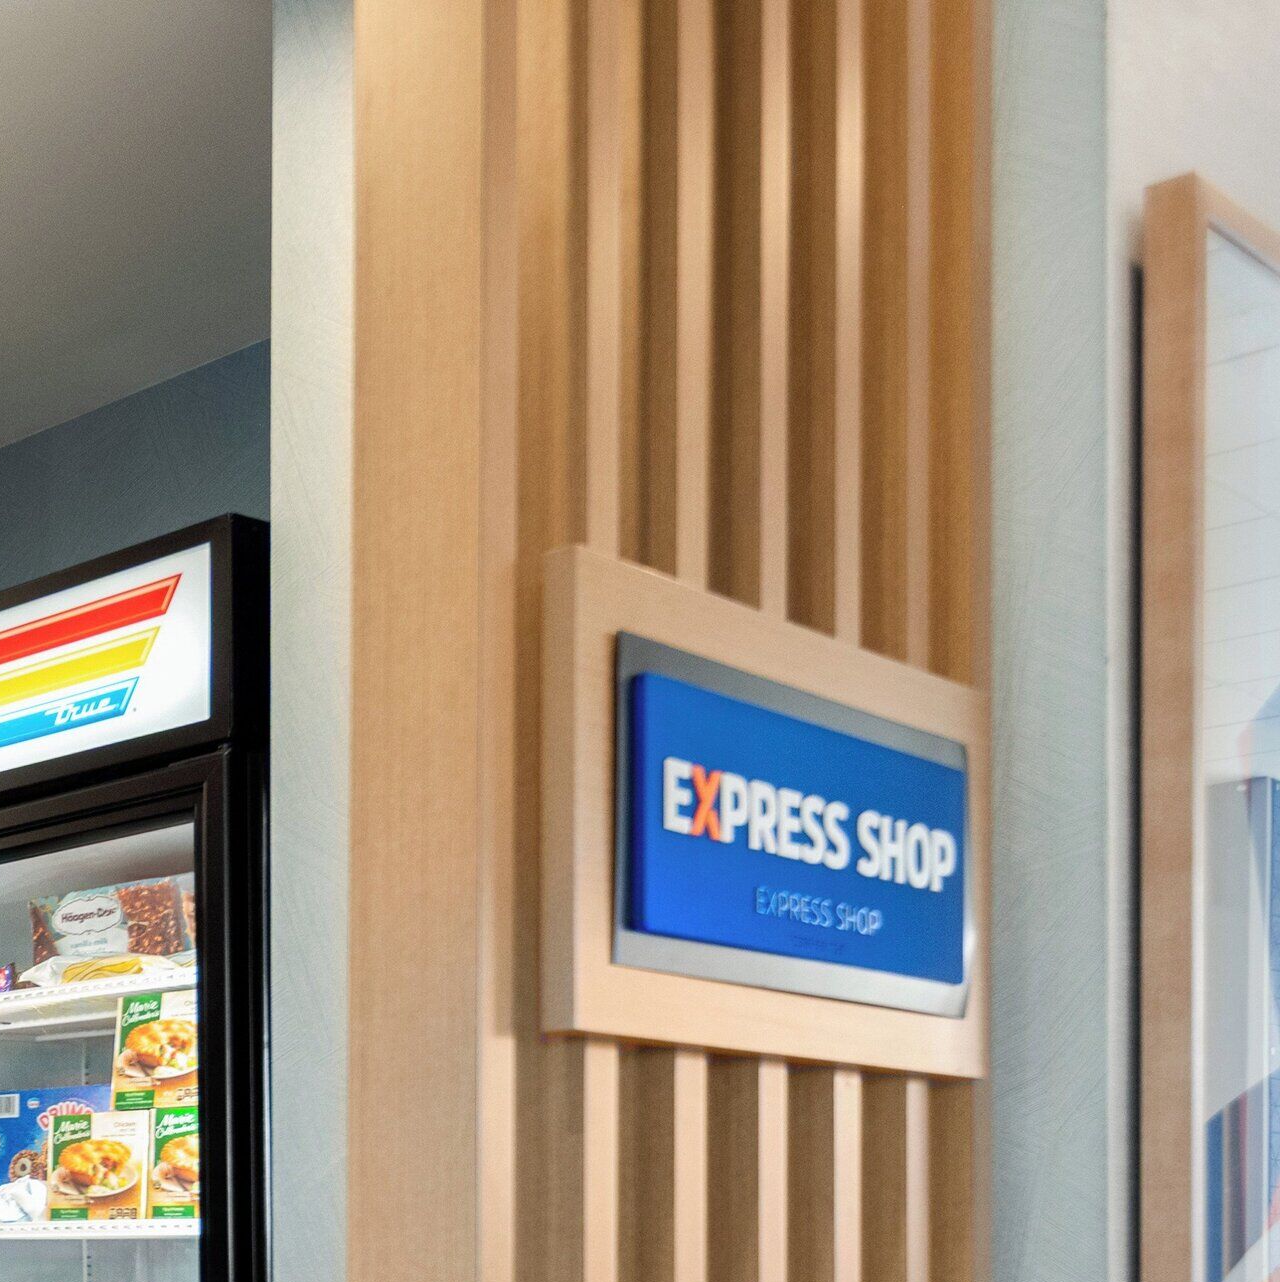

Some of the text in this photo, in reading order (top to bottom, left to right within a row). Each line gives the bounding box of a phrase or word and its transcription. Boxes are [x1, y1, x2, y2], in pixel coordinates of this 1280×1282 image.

[662, 756, 956, 893] EXPRESS SHOP
[755, 886, 883, 936] EXPRESS SHOP
[125, 1000, 158, 1015] Marie
[154, 1107, 195, 1126] Marie
[54, 1120, 89, 1134] Marie
